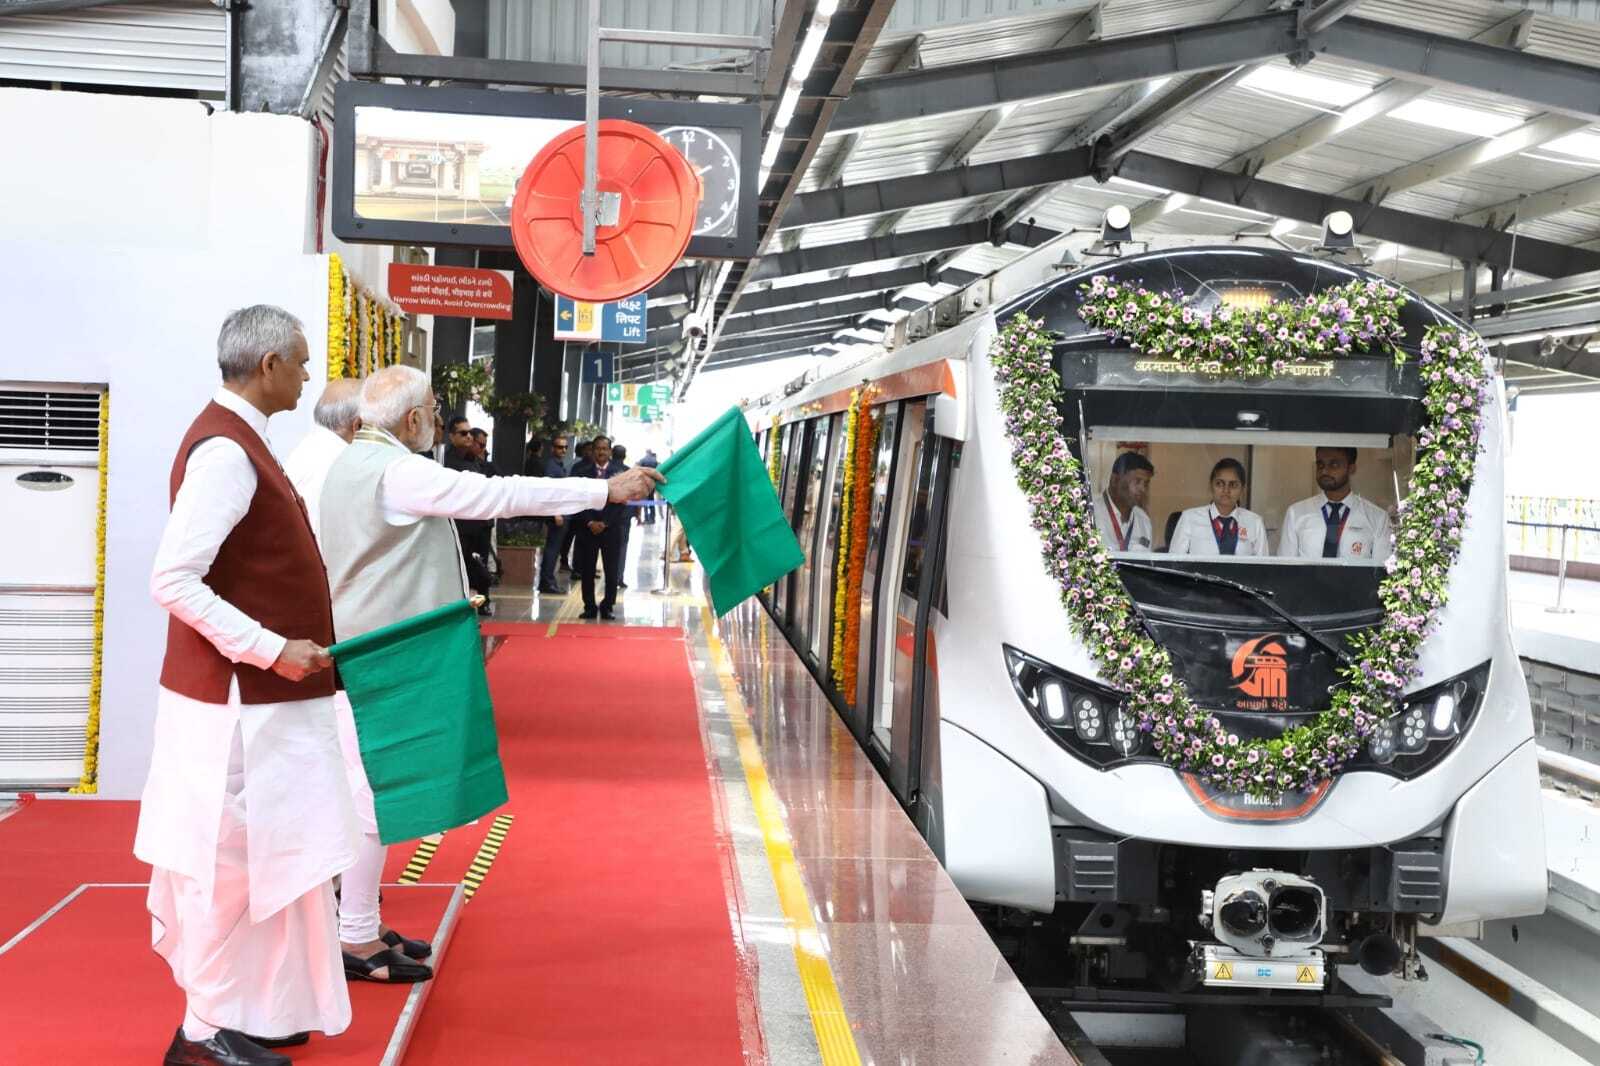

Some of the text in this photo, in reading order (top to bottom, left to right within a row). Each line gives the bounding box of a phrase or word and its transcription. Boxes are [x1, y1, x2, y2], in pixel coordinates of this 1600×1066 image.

[682, 131, 695, 142] 12
[707, 139, 713, 150] 1
[722, 156, 730, 167] 2
[728, 179, 735, 190] 3
[720, 201, 729, 213] 4
[704, 217, 712, 229] 5
[393, 295, 512, 312] Narrow Width, Avoid Overcrowding
[623, 326, 641, 337] Lift
[593, 358, 603, 378] 1
